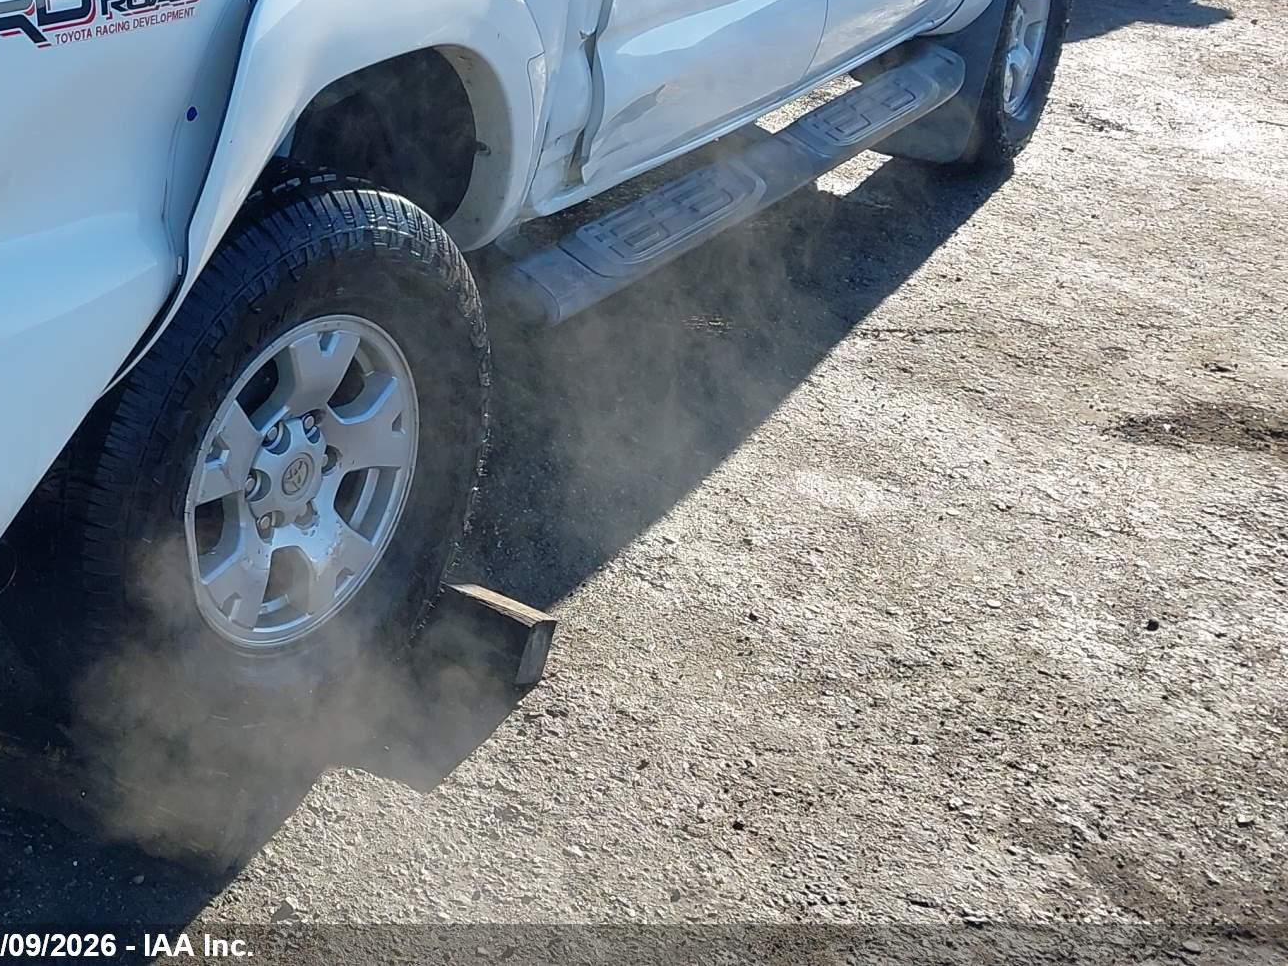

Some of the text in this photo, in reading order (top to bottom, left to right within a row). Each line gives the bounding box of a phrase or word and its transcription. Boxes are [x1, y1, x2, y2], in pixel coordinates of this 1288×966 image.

[54, 7, 196, 45] TOYOTA RACING DEVELOPMENT
